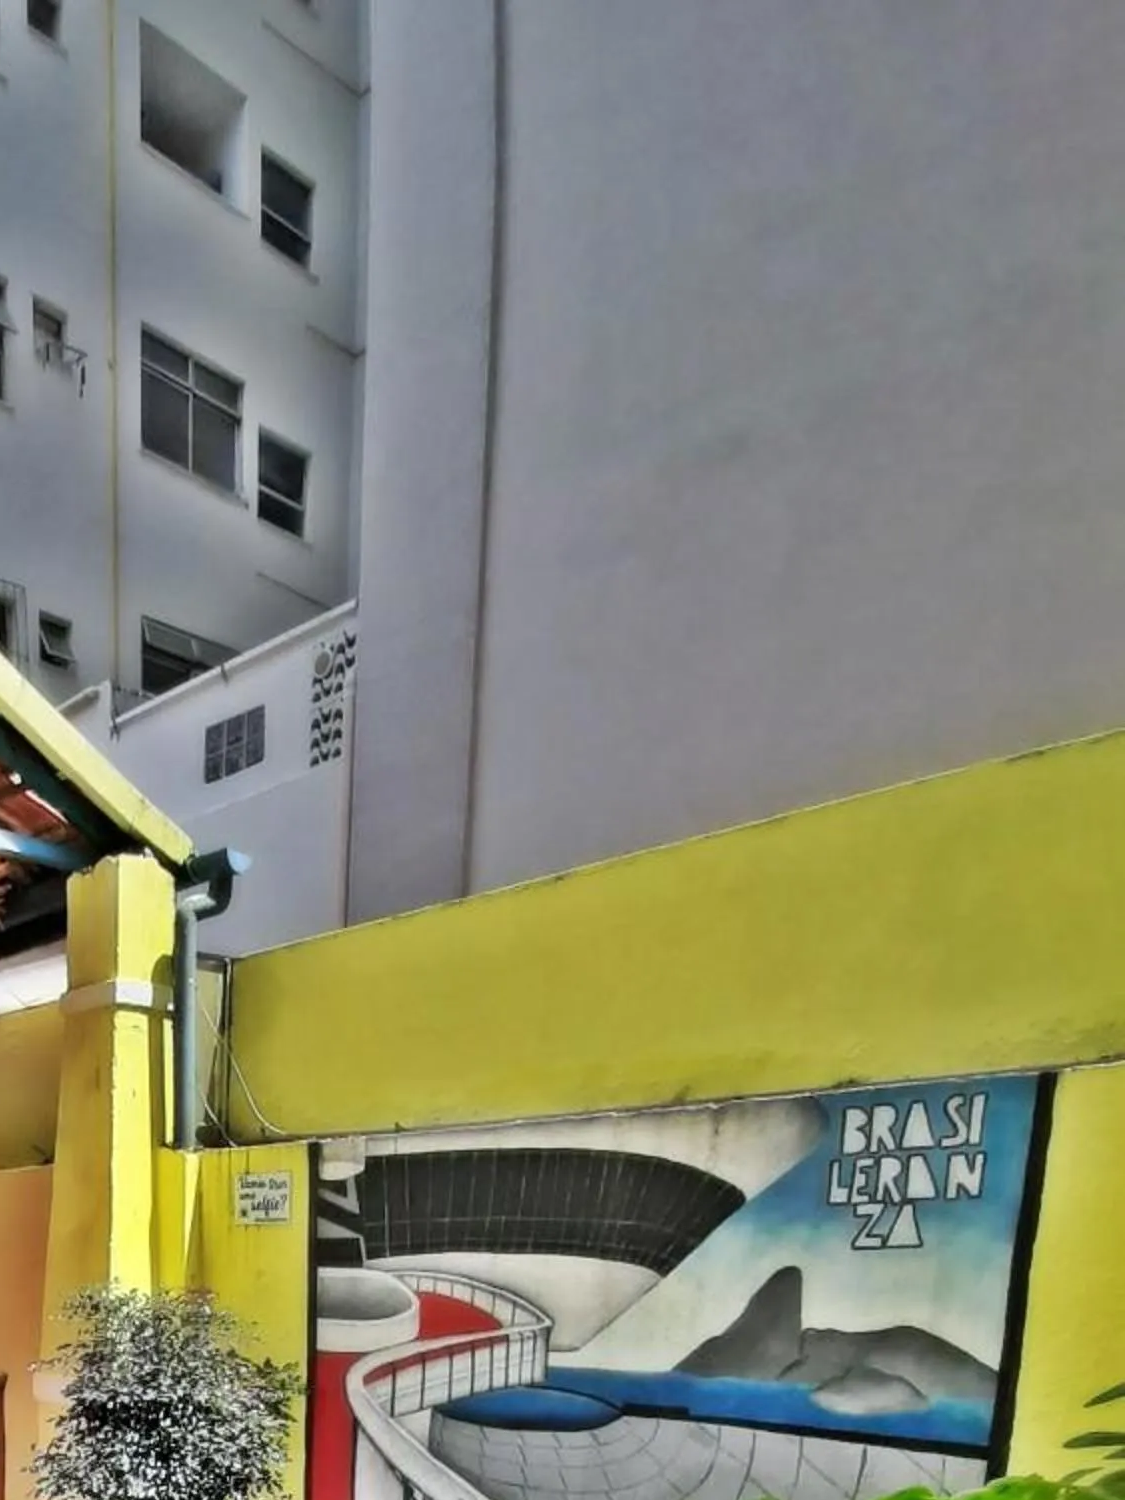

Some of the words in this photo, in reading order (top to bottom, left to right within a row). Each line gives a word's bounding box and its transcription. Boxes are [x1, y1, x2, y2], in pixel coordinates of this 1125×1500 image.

[841, 1092, 988, 1156] BRASI
[827, 1152, 987, 1206] LERAN
[851, 1202, 923, 1250] ZA
